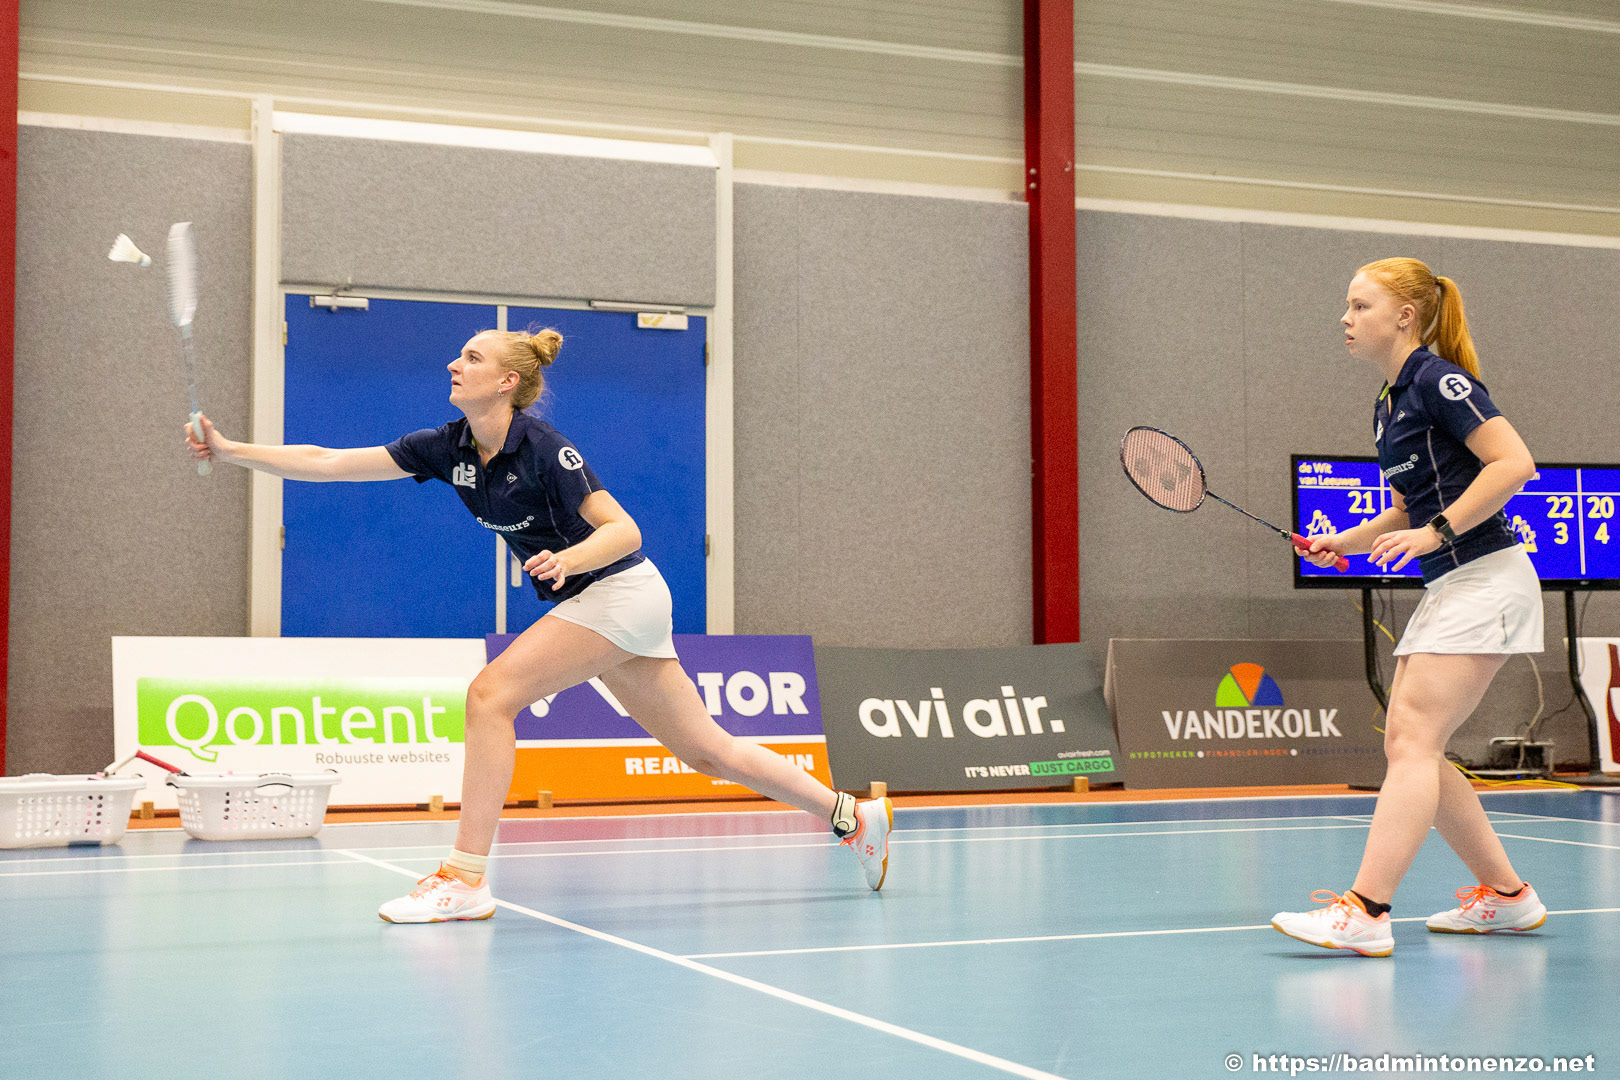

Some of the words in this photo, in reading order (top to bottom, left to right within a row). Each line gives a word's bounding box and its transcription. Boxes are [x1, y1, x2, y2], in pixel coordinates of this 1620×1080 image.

[1299, 462, 1312, 473] de
[1347, 491, 1376, 514] 21
[1545, 496, 1575, 518] 22
[1586, 496, 1615, 518] 20
[1553, 522, 1569, 545] 3
[1594, 522, 1611, 545] 4
[858, 687, 954, 738] avi
[962, 685, 1066, 738] air.
[165, 693, 450, 763] Qontent
[1161, 708, 1342, 740] VANDEKOLK
[315, 752, 384, 765] Robuuste
[387, 750, 450, 763] websites
[625, 757, 698, 775] REA
[965, 766, 989, 778] IT'S
[989, 764, 1031, 777] NEVER
[1033, 762, 1064, 774] JUST
[1066, 759, 1111, 772] CARGO
